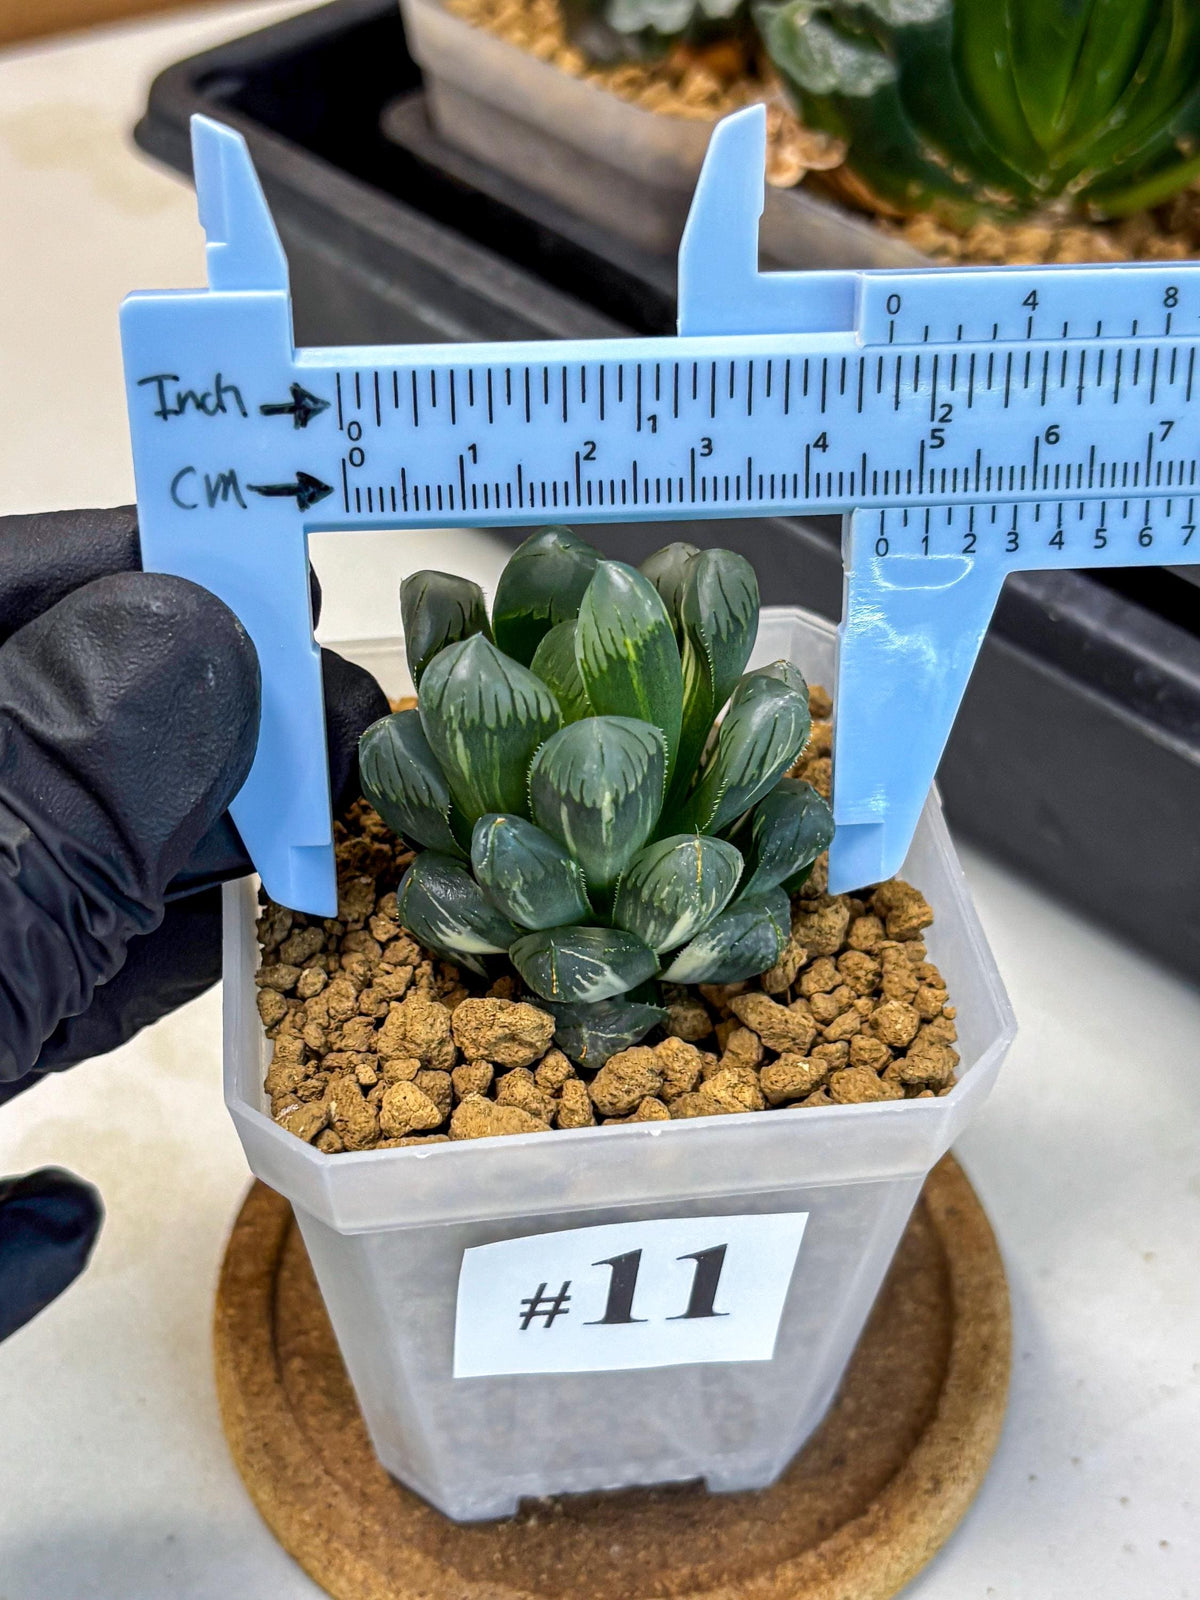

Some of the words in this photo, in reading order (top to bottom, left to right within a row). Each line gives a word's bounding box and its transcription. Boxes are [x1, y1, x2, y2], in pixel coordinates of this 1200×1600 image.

[886, 294, 901, 315] 0
[1021, 290, 1039, 312] 4
[1163, 286, 1179, 308] 8
[137, 373, 248, 422] Inch
[347, 421, 362, 442] 0
[646, 414, 657, 434] 1
[937, 404, 953, 424] 2
[348, 447, 365, 467] 0
[468, 443, 478, 465] 1
[583, 441, 597, 461] 2
[700, 437, 714, 457] 3
[813, 432, 829, 453] 4
[929, 428, 945, 449] 5
[1044, 424, 1060, 445] 6
[1160, 421, 1175, 442] 7
[875, 538, 889, 557] 0
[921, 535, 930, 556] 1
[962, 533, 977, 554] 2
[1005, 531, 1019, 552] 3
[1048, 530, 1065, 550] 4
[1094, 528, 1107, 549] 5
[1138, 527, 1153, 547] 6
[1181, 525, 1196, 546] 7
[519, 1243, 730, 1331] #11
